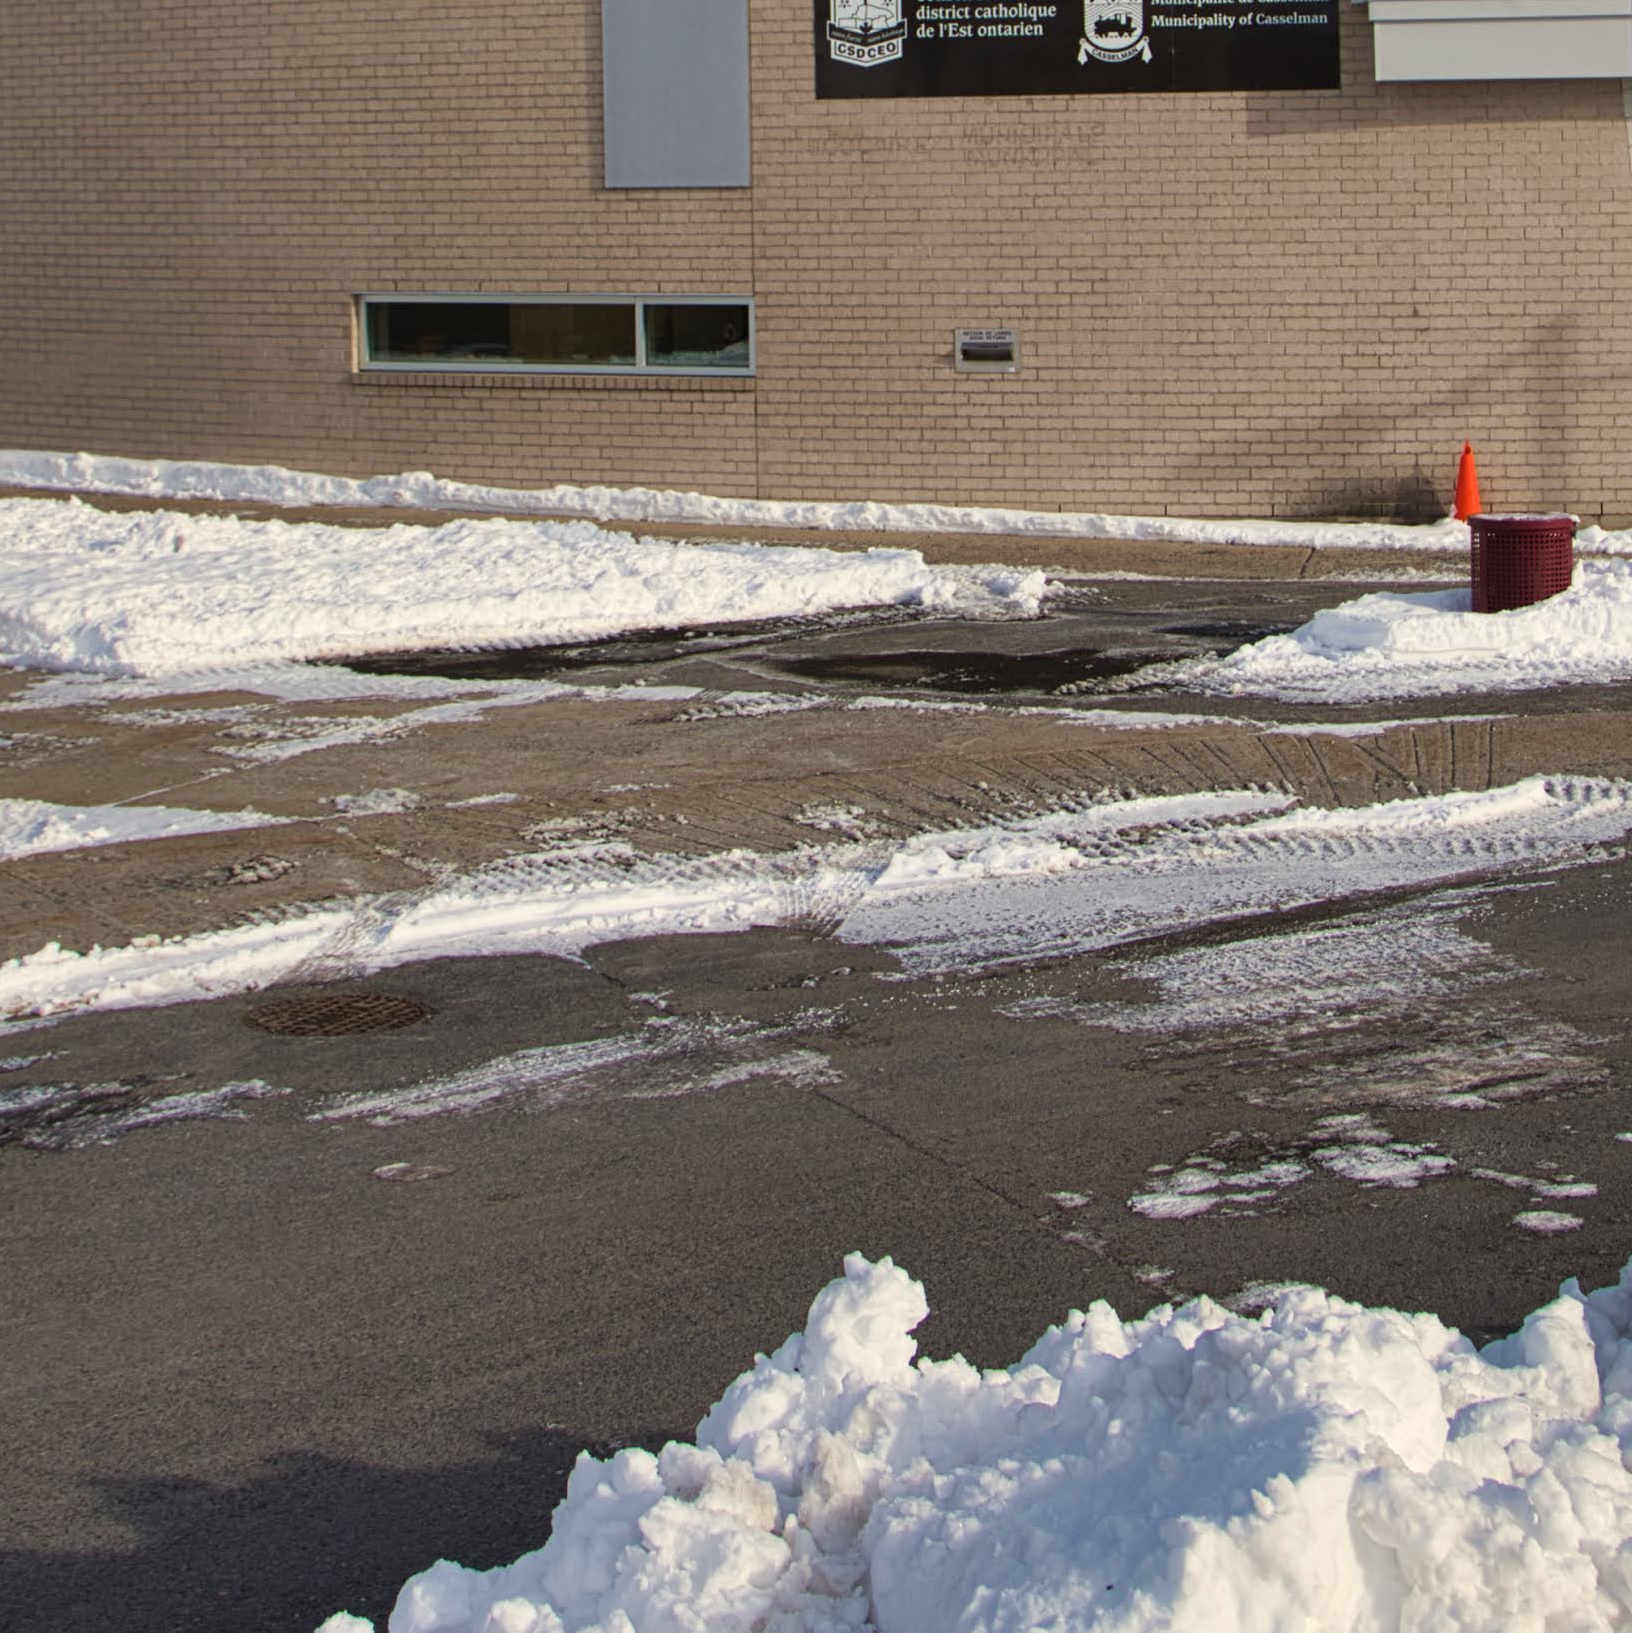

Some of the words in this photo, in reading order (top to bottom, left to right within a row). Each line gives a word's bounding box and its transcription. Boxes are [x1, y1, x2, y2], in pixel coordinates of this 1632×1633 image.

[916, 4, 971, 20] district
[974, 3, 1057, 22] catholique
[1151, 12, 1236, 29] Municipality
[1239, 12, 1253, 26] of
[1255, 12, 1329, 25] Casselman
[916, 23, 935, 38] de
[939, 22, 974, 38] l'Est
[977, 21, 1044, 37] ontarien
[837, 42, 896, 59] CSDCEO
[1091, 47, 1139, 62] CASSELMAN
